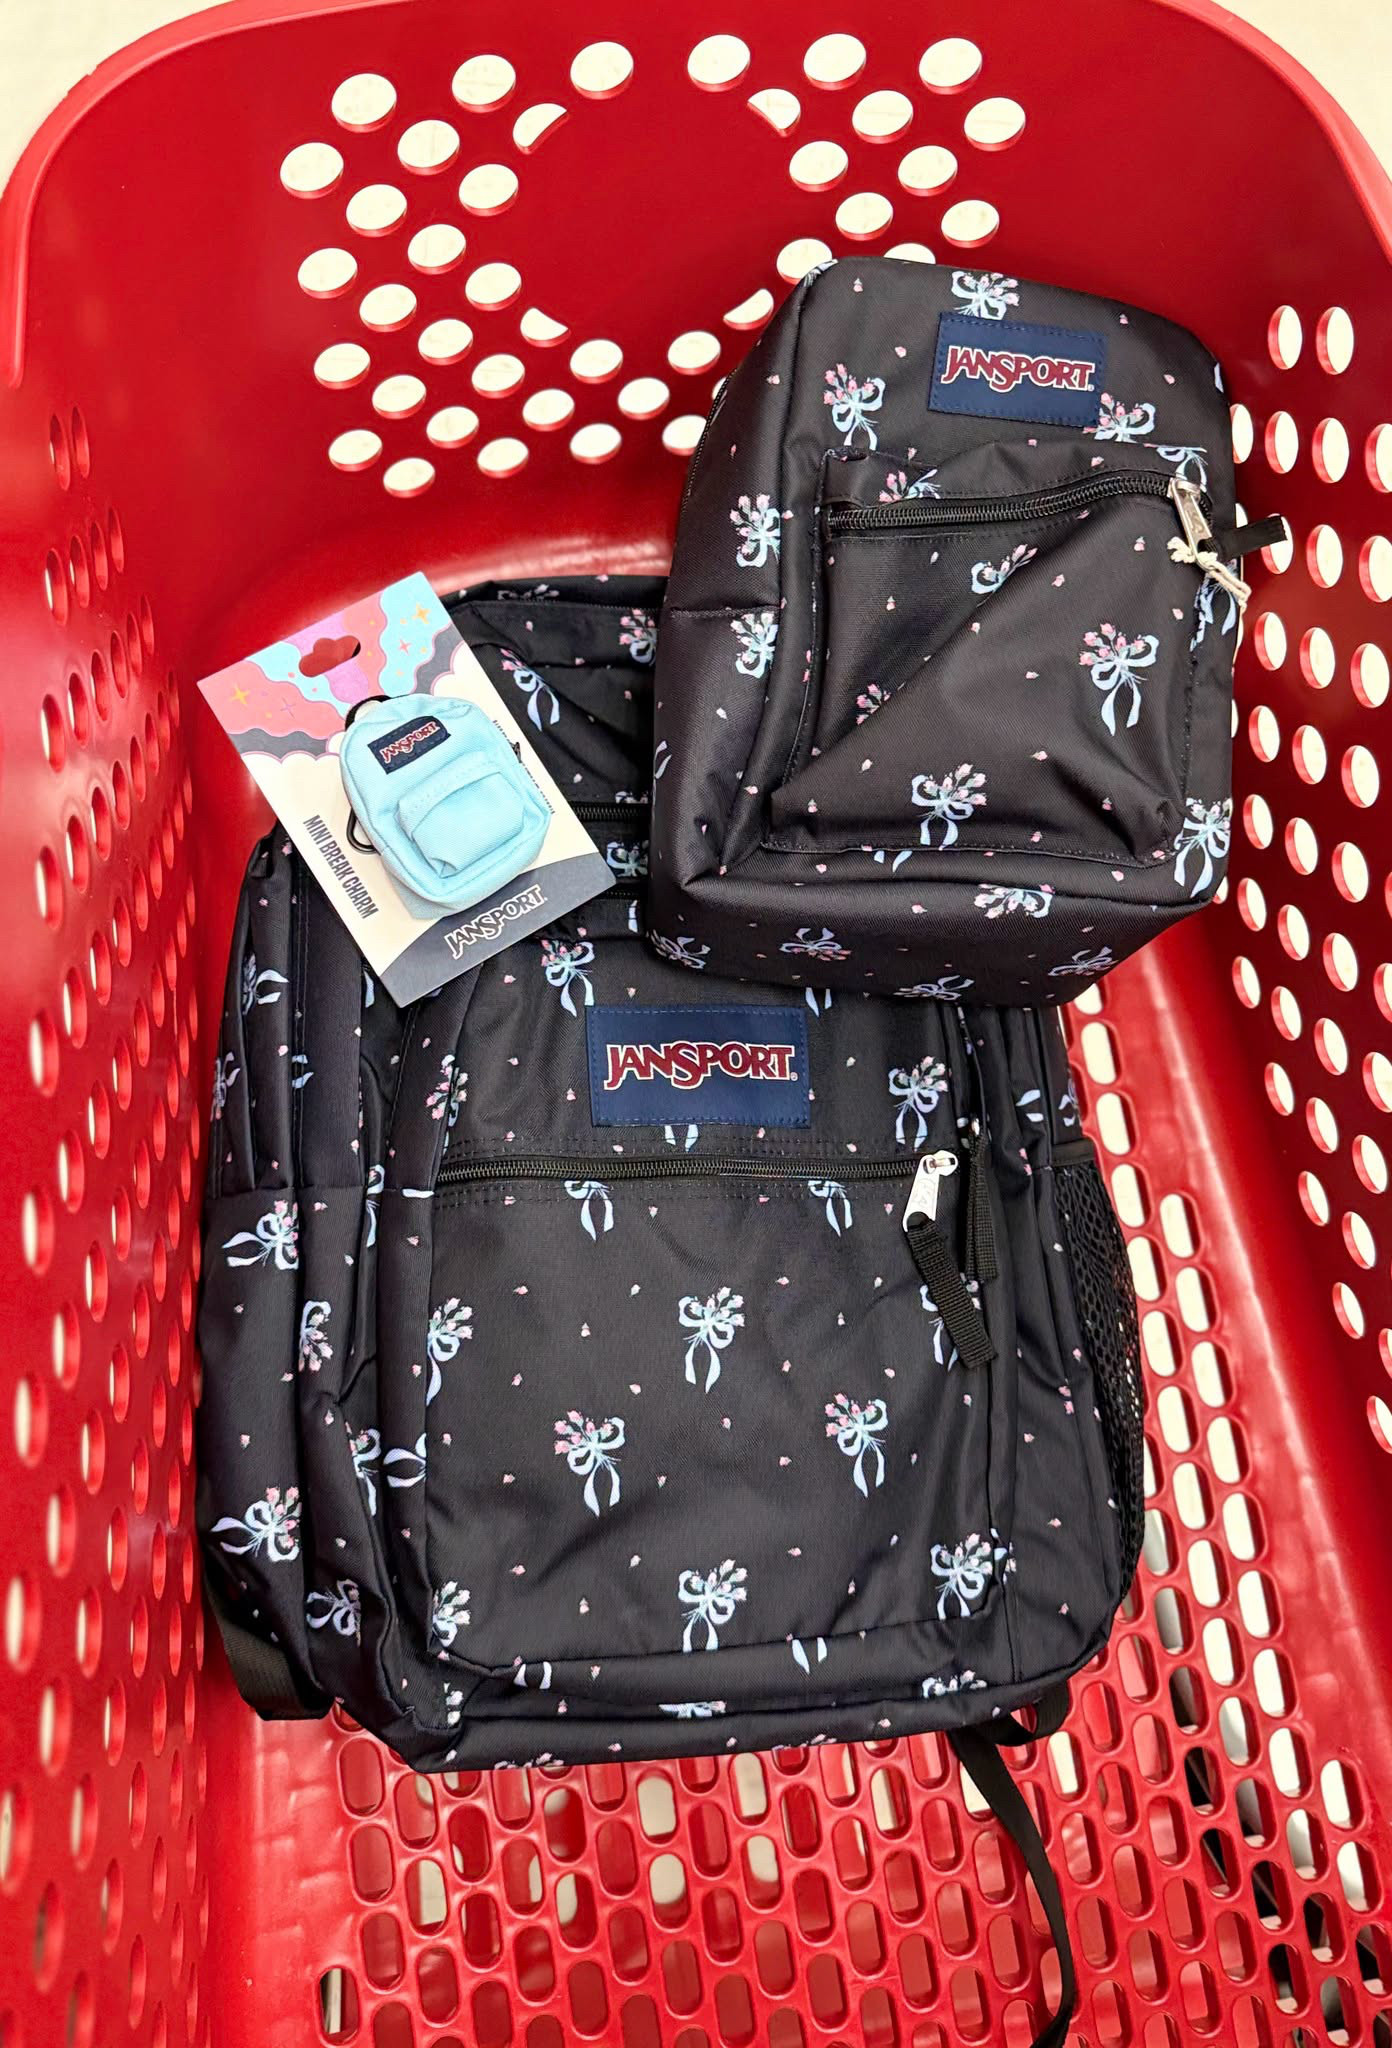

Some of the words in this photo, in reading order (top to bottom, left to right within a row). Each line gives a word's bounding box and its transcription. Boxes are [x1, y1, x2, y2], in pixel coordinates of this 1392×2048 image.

[941, 345, 1095, 393] JANSPORT
[379, 721, 440, 764] JANSPORT
[303, 814, 332, 845] MINI
[319, 840, 355, 880] BREAK
[342, 876, 379, 919] CHARM
[444, 884, 547, 960] JANSPORT
[604, 1040, 797, 1091] JANSPORT
